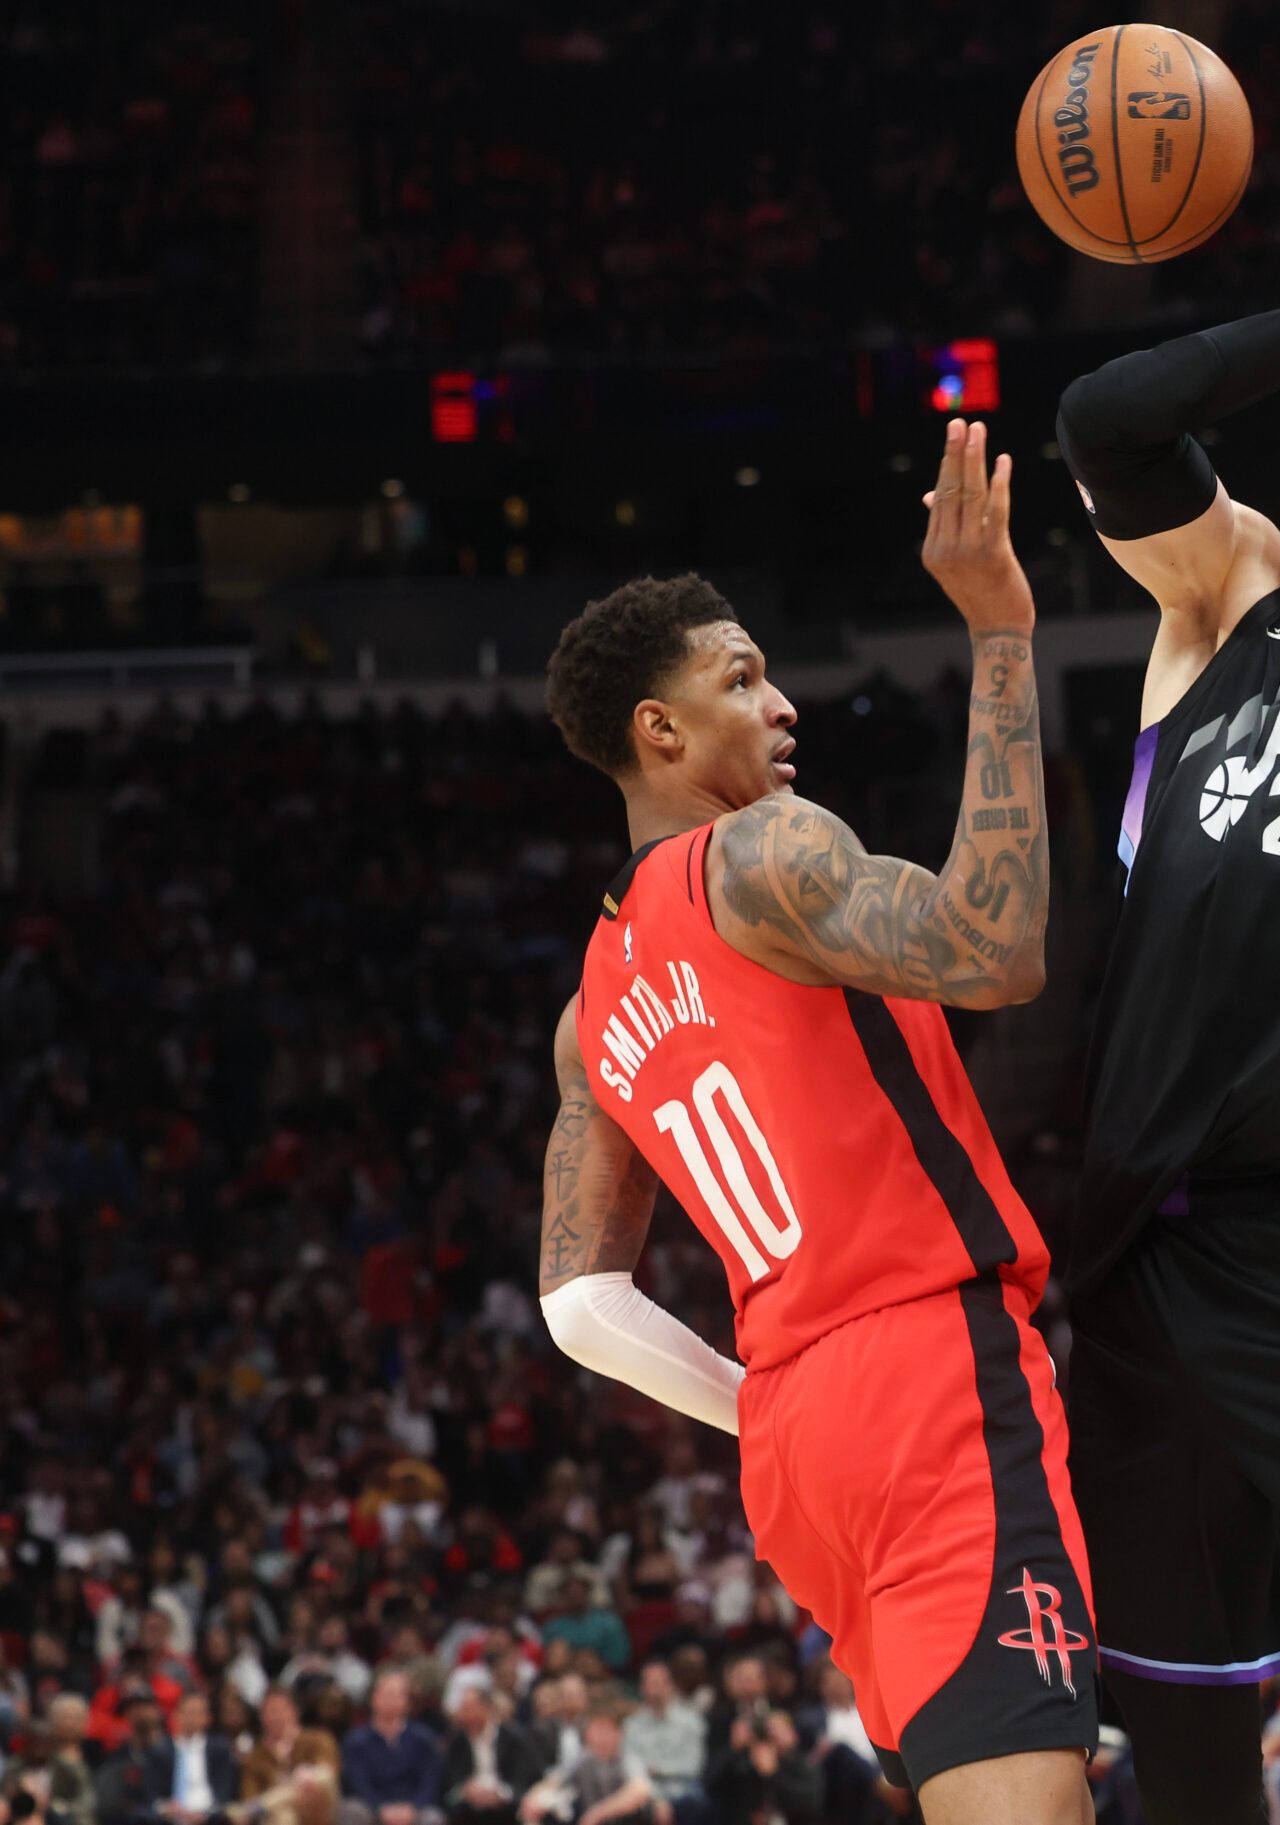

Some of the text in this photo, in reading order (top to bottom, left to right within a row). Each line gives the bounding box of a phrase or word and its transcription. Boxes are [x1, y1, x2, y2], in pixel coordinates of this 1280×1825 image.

[1054, 42, 1103, 198] Wilson
[599, 960, 716, 1102] SMITH JR.
[652, 1060, 802, 1282] 10
